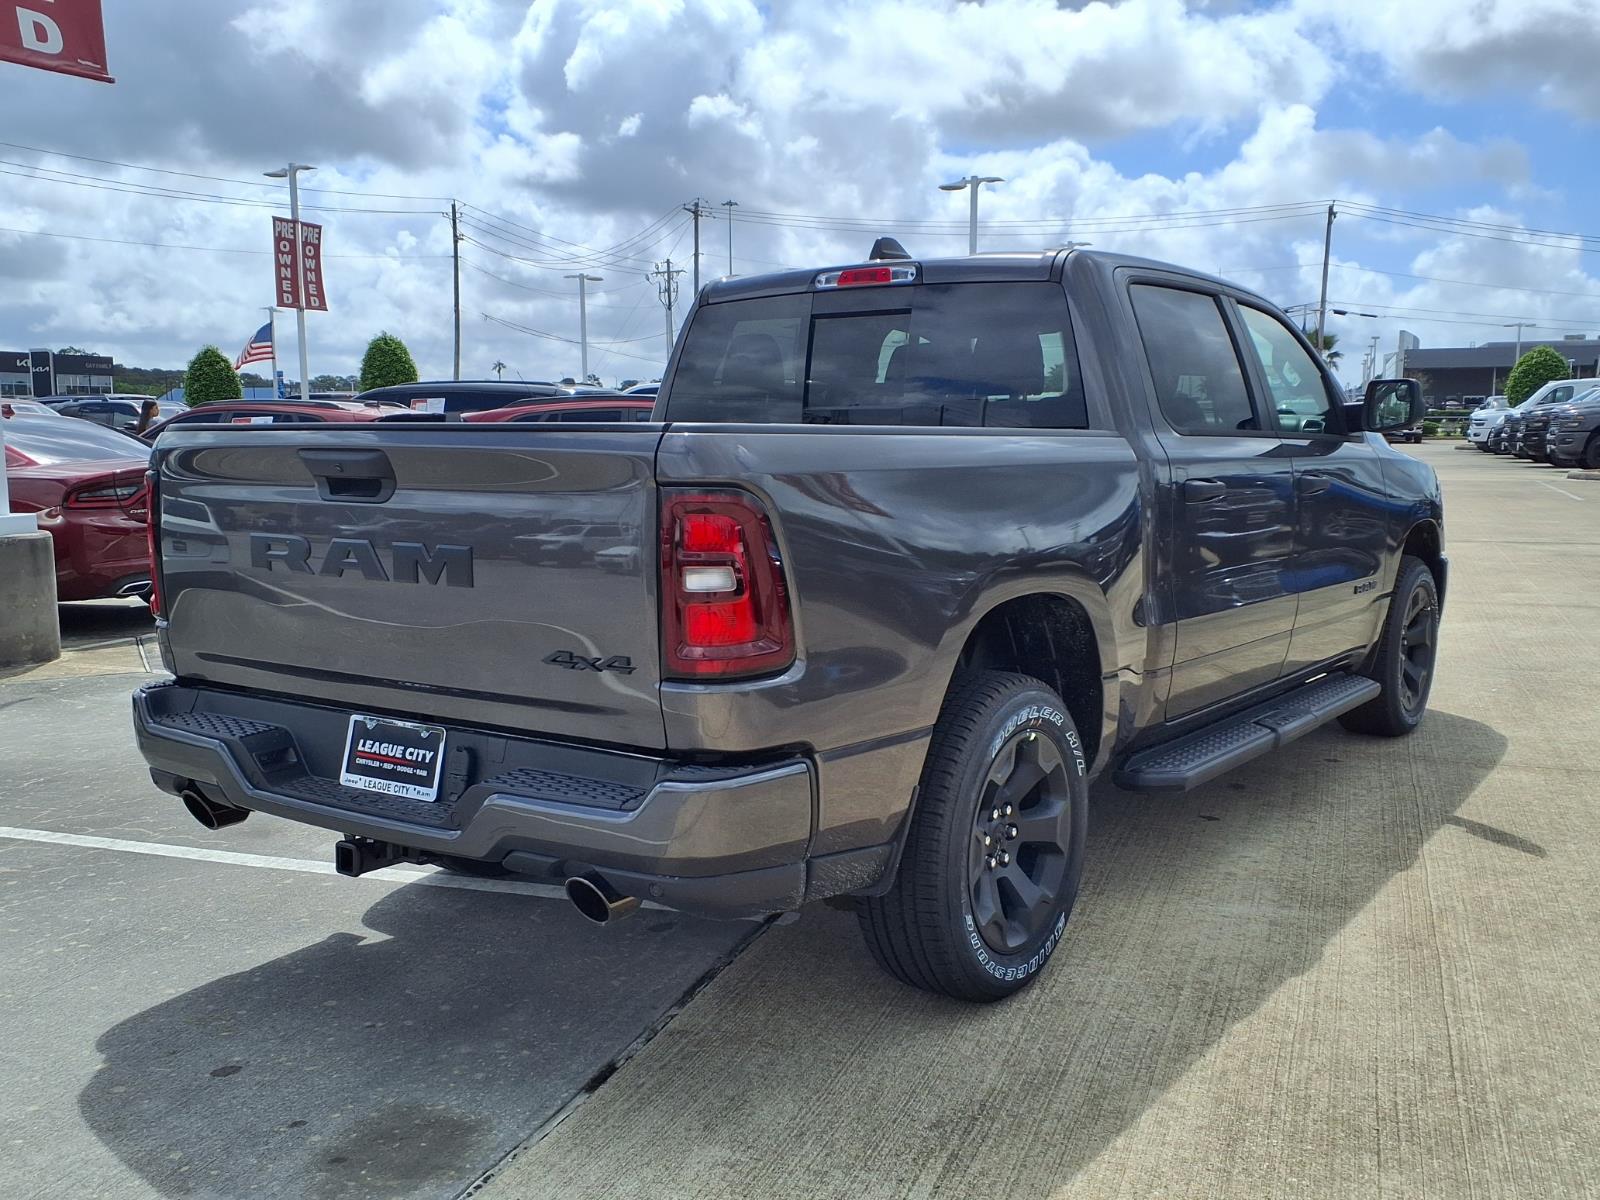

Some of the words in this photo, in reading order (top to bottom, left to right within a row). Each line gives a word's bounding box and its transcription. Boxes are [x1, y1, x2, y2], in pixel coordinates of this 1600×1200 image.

[275, 220, 294, 239] PRE
[302, 225, 320, 244] PRE
[278, 240, 293, 304] OWNED
[304, 245, 320, 307] OWNED
[249, 532, 474, 588] RAM
[541, 649, 638, 675] 4x4
[355, 757, 380, 768] CHRYSLER
[357, 739, 404, 758] LEAGUE
[405, 747, 434, 763] CITY
[363, 779, 392, 792] LEAGUE
[393, 784, 411, 795] CITY
